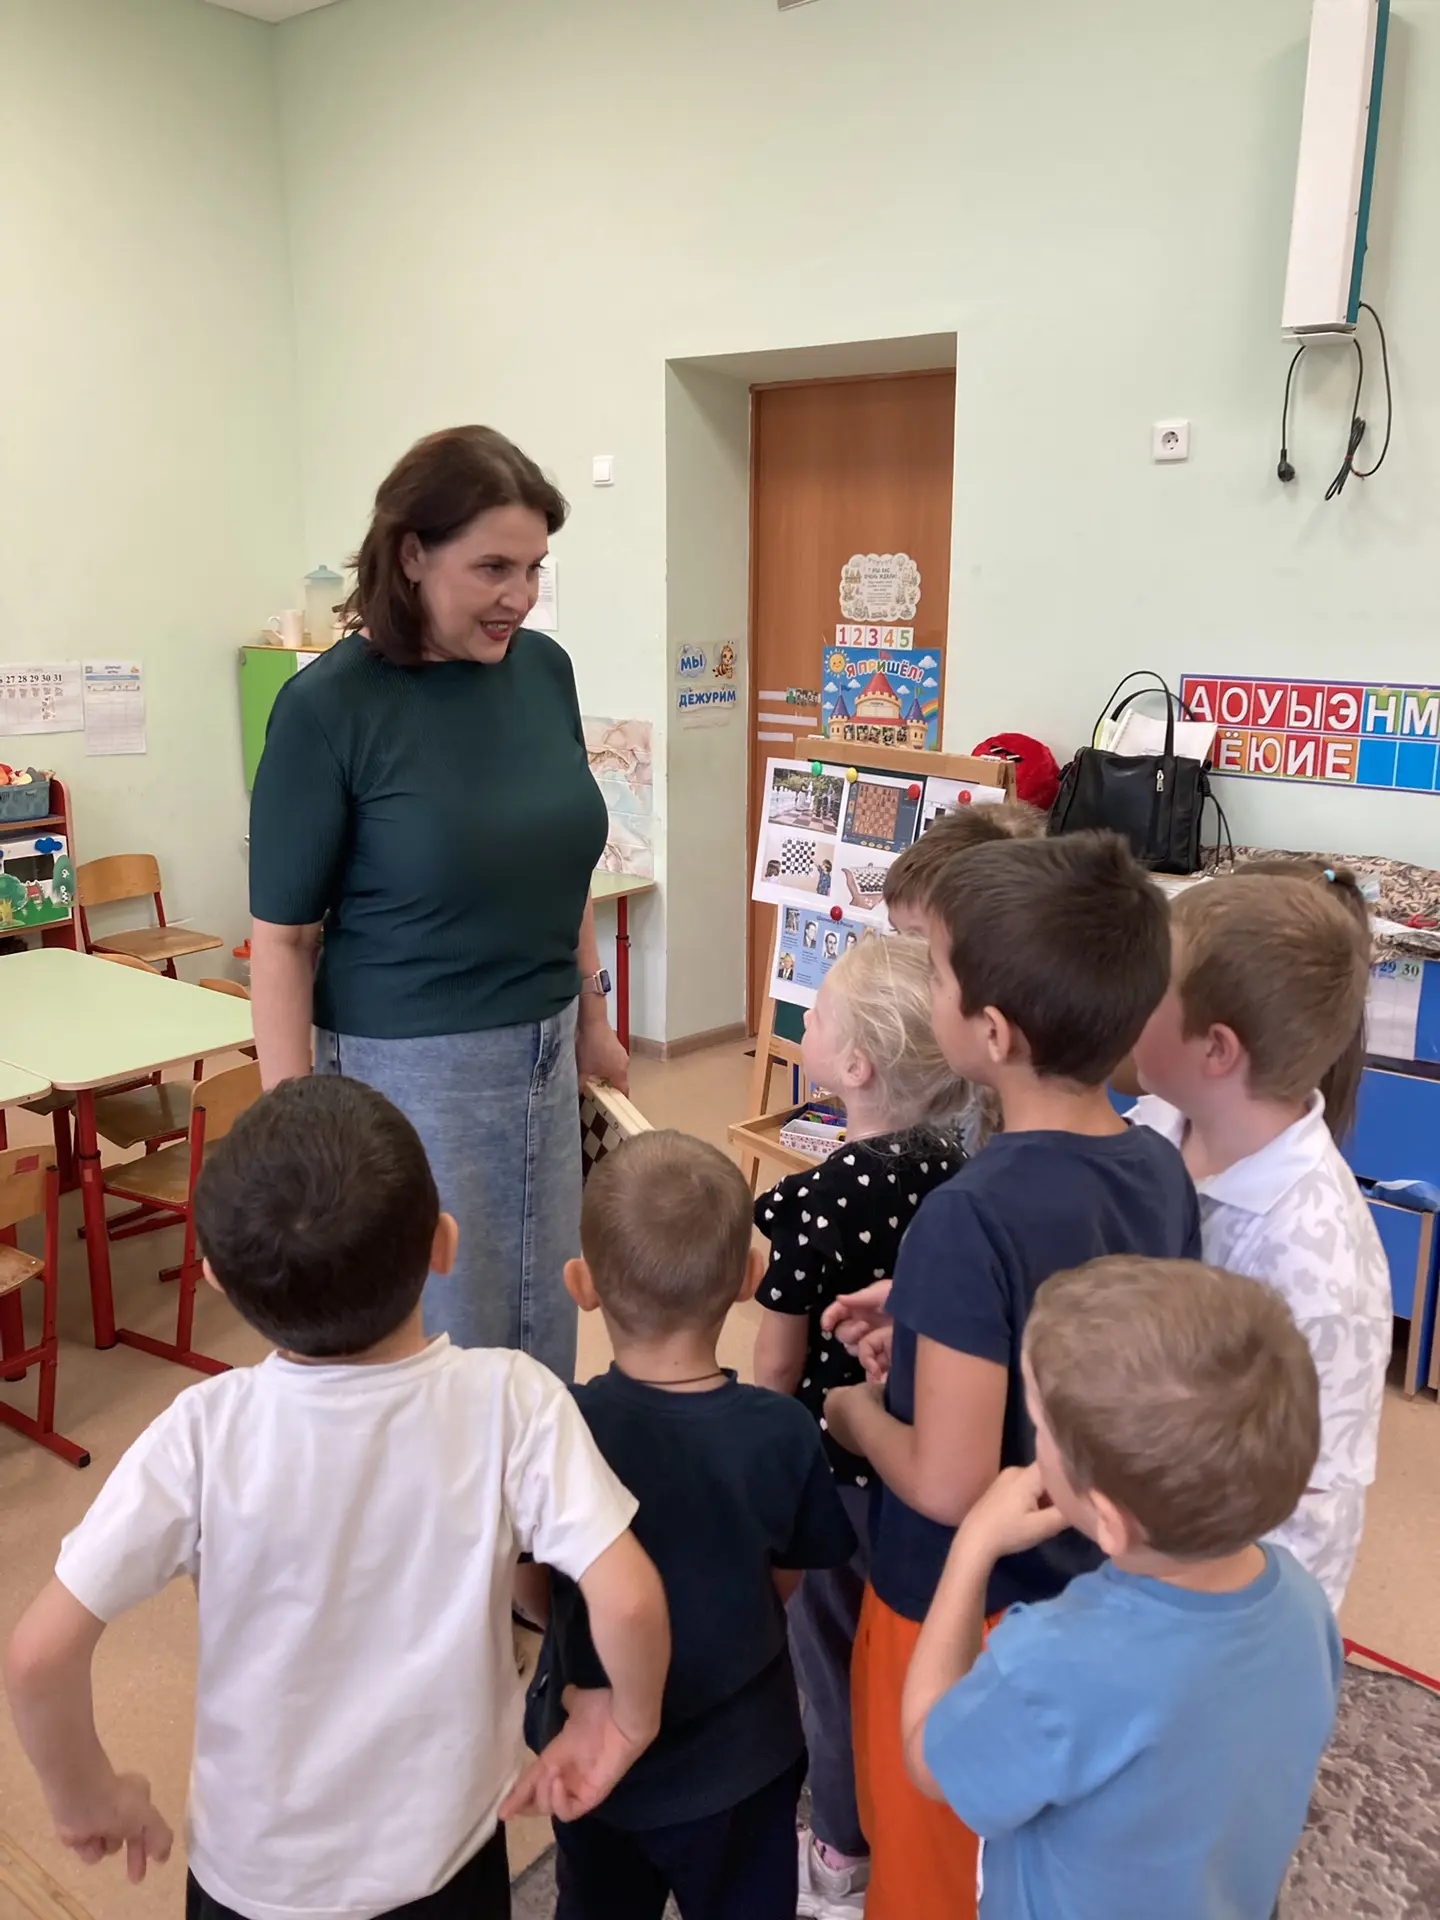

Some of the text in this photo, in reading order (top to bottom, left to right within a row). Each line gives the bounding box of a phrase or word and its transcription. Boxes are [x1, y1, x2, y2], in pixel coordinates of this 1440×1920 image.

[681, 655, 703, 671] МЫ
[6, 676, 15, 684] 27
[18, 675, 28, 683] 28
[30, 674, 39, 683] 29
[53, 674, 62, 682] 31
[846, 661, 923, 682] Я ПРИШЁЛ!
[679, 690, 736, 707] ДЕЖУРИМ
[1380, 961, 1396, 973] 29
[1402, 963, 1420, 977] 30
